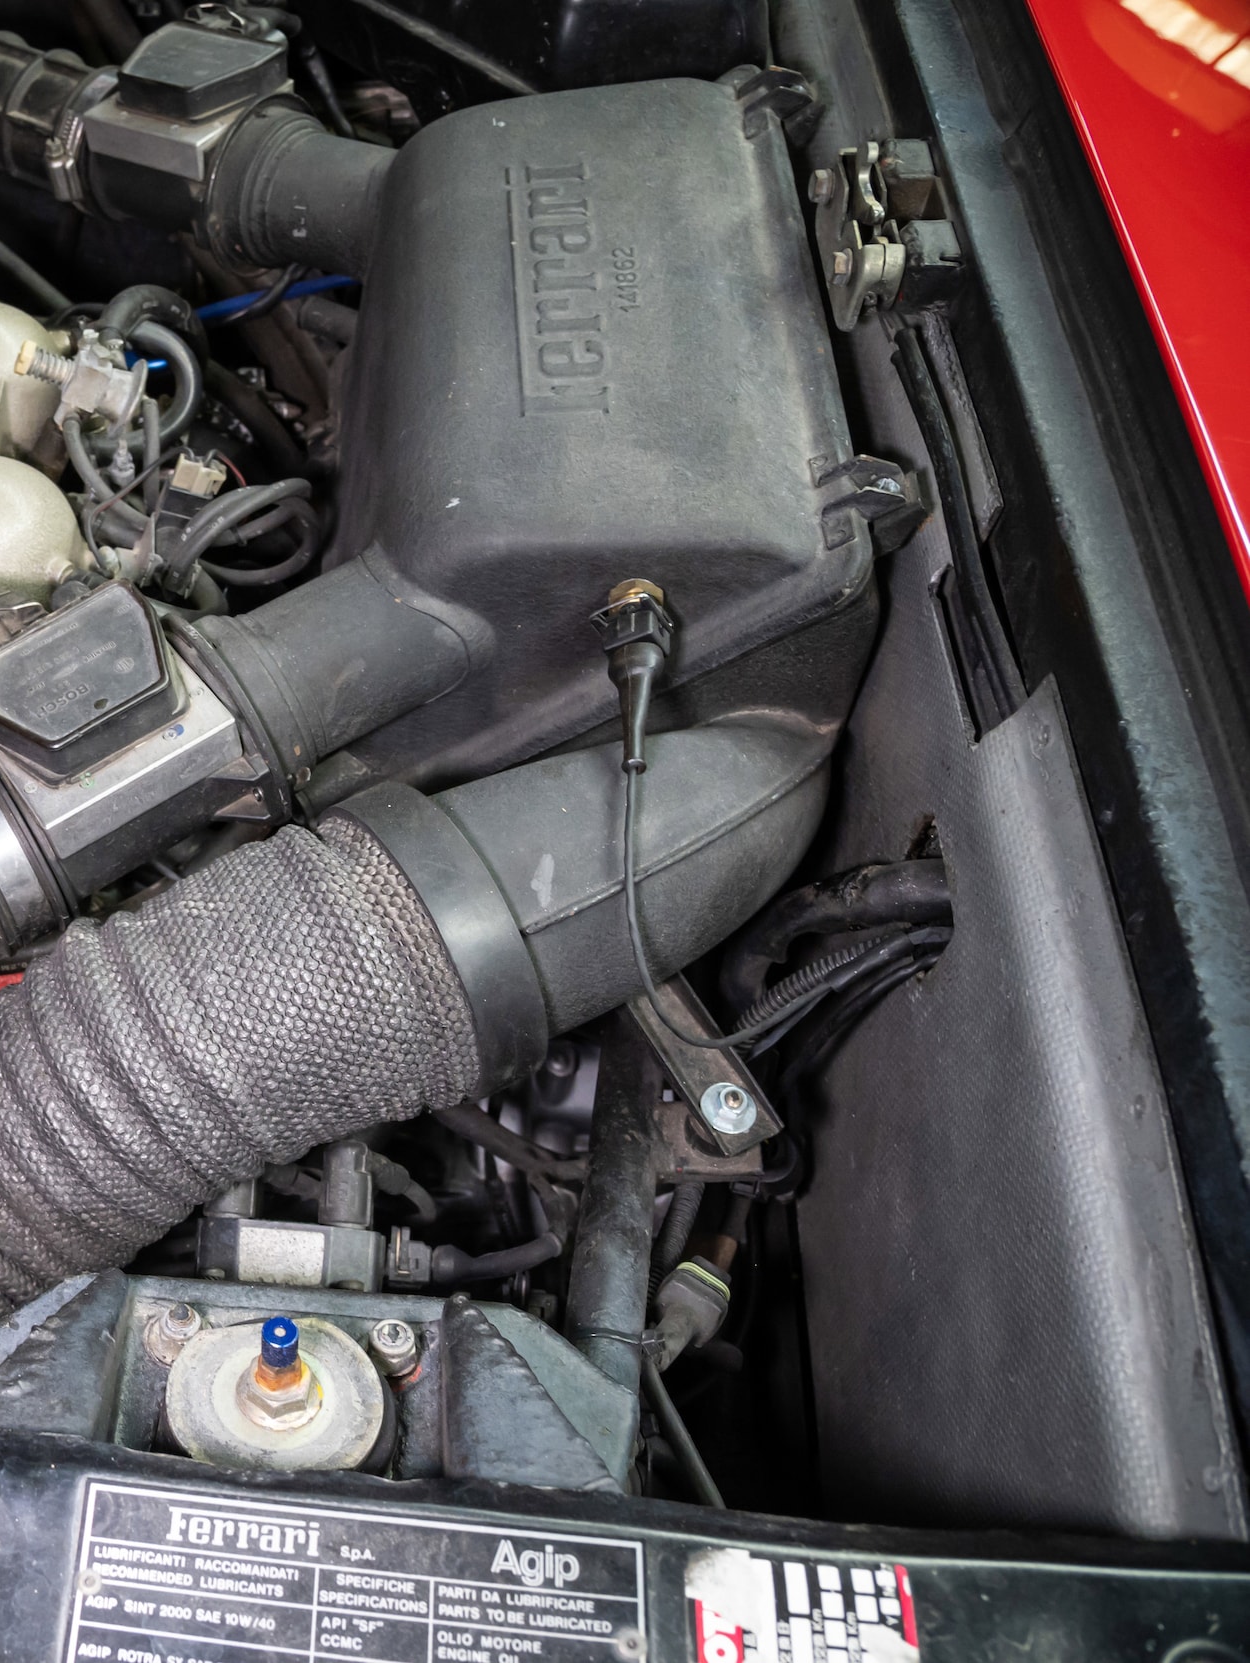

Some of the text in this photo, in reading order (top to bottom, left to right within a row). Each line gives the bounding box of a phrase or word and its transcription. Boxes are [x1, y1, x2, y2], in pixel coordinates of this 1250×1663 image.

[505, 162, 609, 417] Ferrari
[612, 247, 640, 312] 141862
[37, 683, 89, 718] BOSCH
[166, 1506, 320, 1557] Ferrari
[94, 1545, 299, 1581] LUBRIFICANTI RACCOMANDATI
[490, 1538, 580, 1588] Agip
[92, 1562, 284, 1598] RECOMMENDED LUBRICANTS
[336, 1573, 416, 1595] SPECIFICHE
[85, 1595, 118, 1610] AGIP
[124, 1599, 157, 1615] SINT
[159, 1606, 192, 1620] 2000
[195, 1609, 221, 1624] SAE
[319, 1590, 428, 1614] SPECIFICATIONS
[438, 1584, 595, 1613] PARTI DA LUBRIFICARE
[321, 1616, 384, 1633] API "SF"
[438, 1603, 612, 1634] PARTS TO BE LUBRICATED
[78, 1643, 111, 1659] AGIP
[117, 1648, 162, 1663] ROTRA
[320, 1635, 363, 1650] CCMC
[437, 1631, 542, 1654] OLIO MOTORE
[438, 1646, 490, 1663] ENGINE
